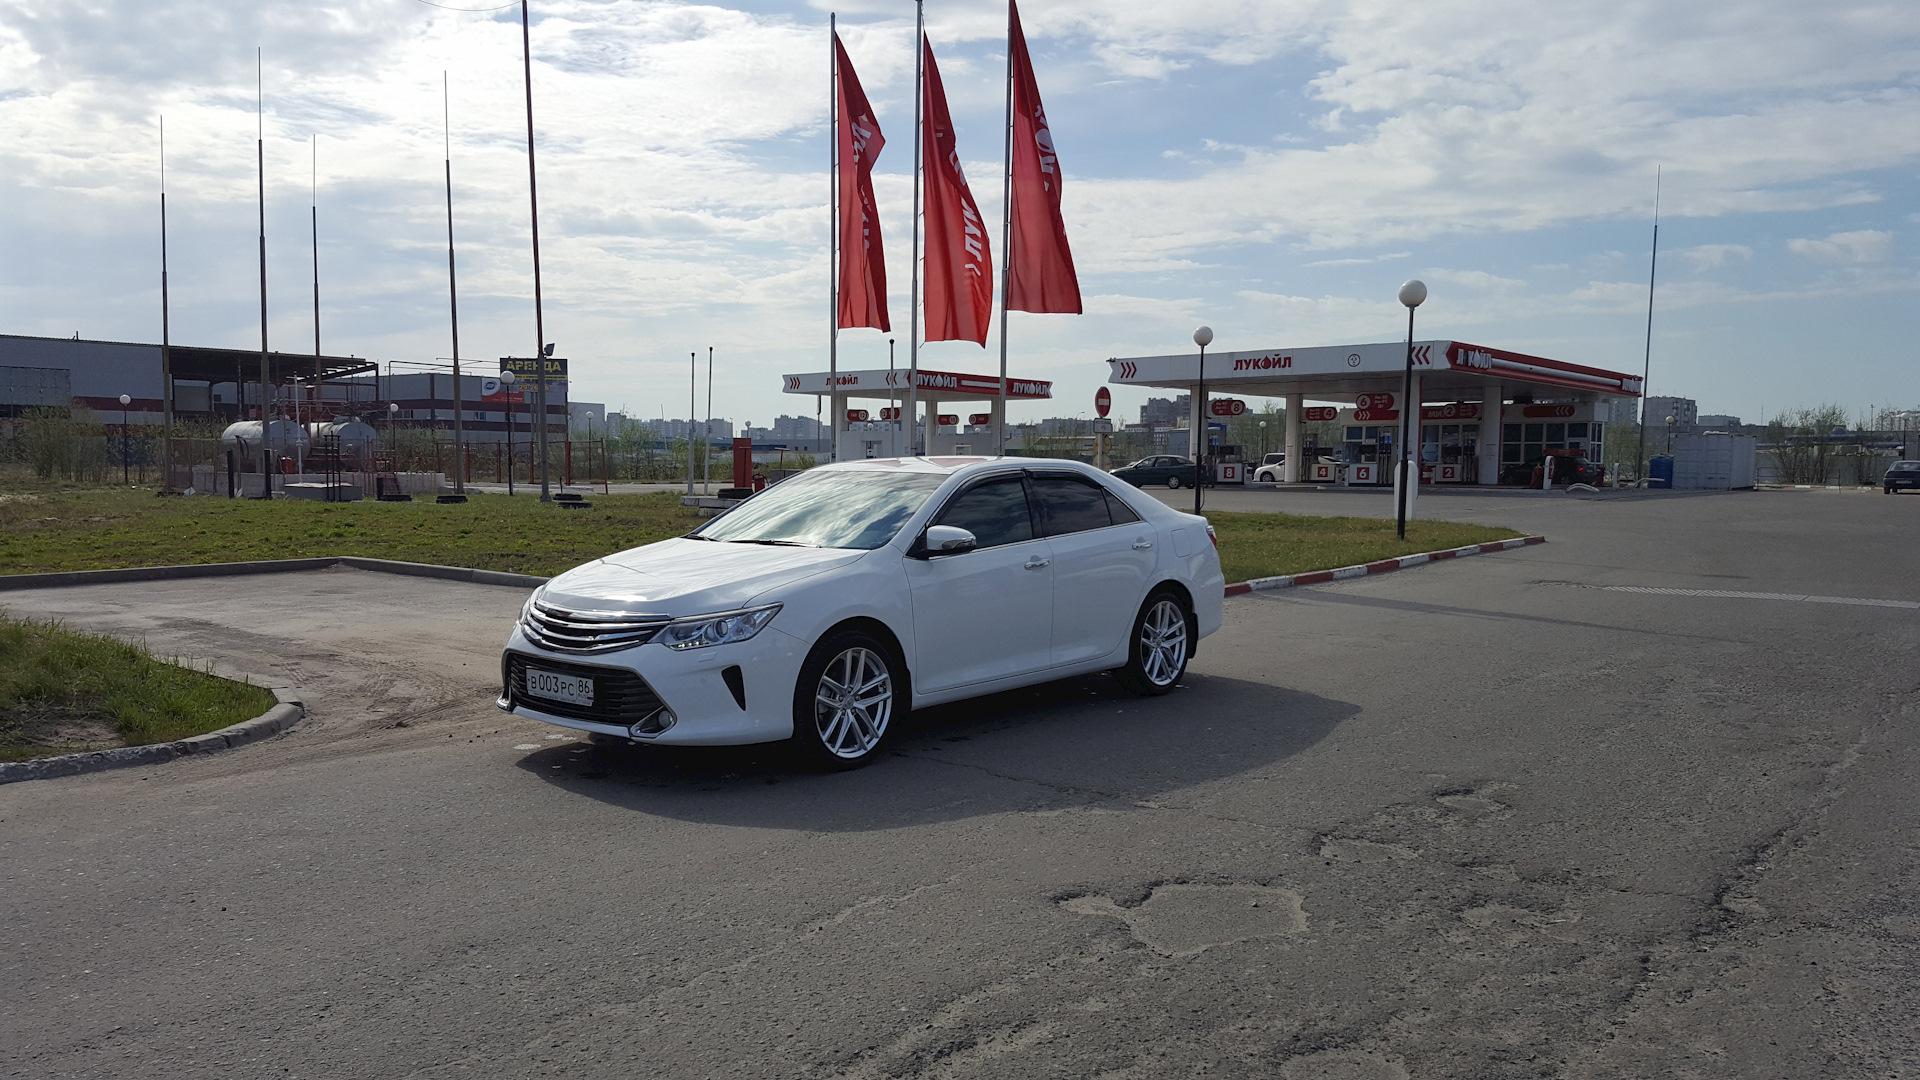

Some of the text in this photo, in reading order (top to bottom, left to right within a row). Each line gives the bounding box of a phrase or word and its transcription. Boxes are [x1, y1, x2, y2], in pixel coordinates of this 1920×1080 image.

[1233, 353, 1292, 371] ЛУКОЙЛ
[1456, 348, 1492, 368] ЛКОЙЛ
[825, 374, 859, 386] ЛКОЙЛ
[916, 374, 957, 388] ЛУКОЙЛ
[1012, 382, 1047, 396] ЛУКОЙЛ
[1226, 468, 1233, 478] 8
[1319, 467, 1327, 477] 4
[1359, 469, 1367, 479] 6
[1445, 468, 1453, 478] 2
